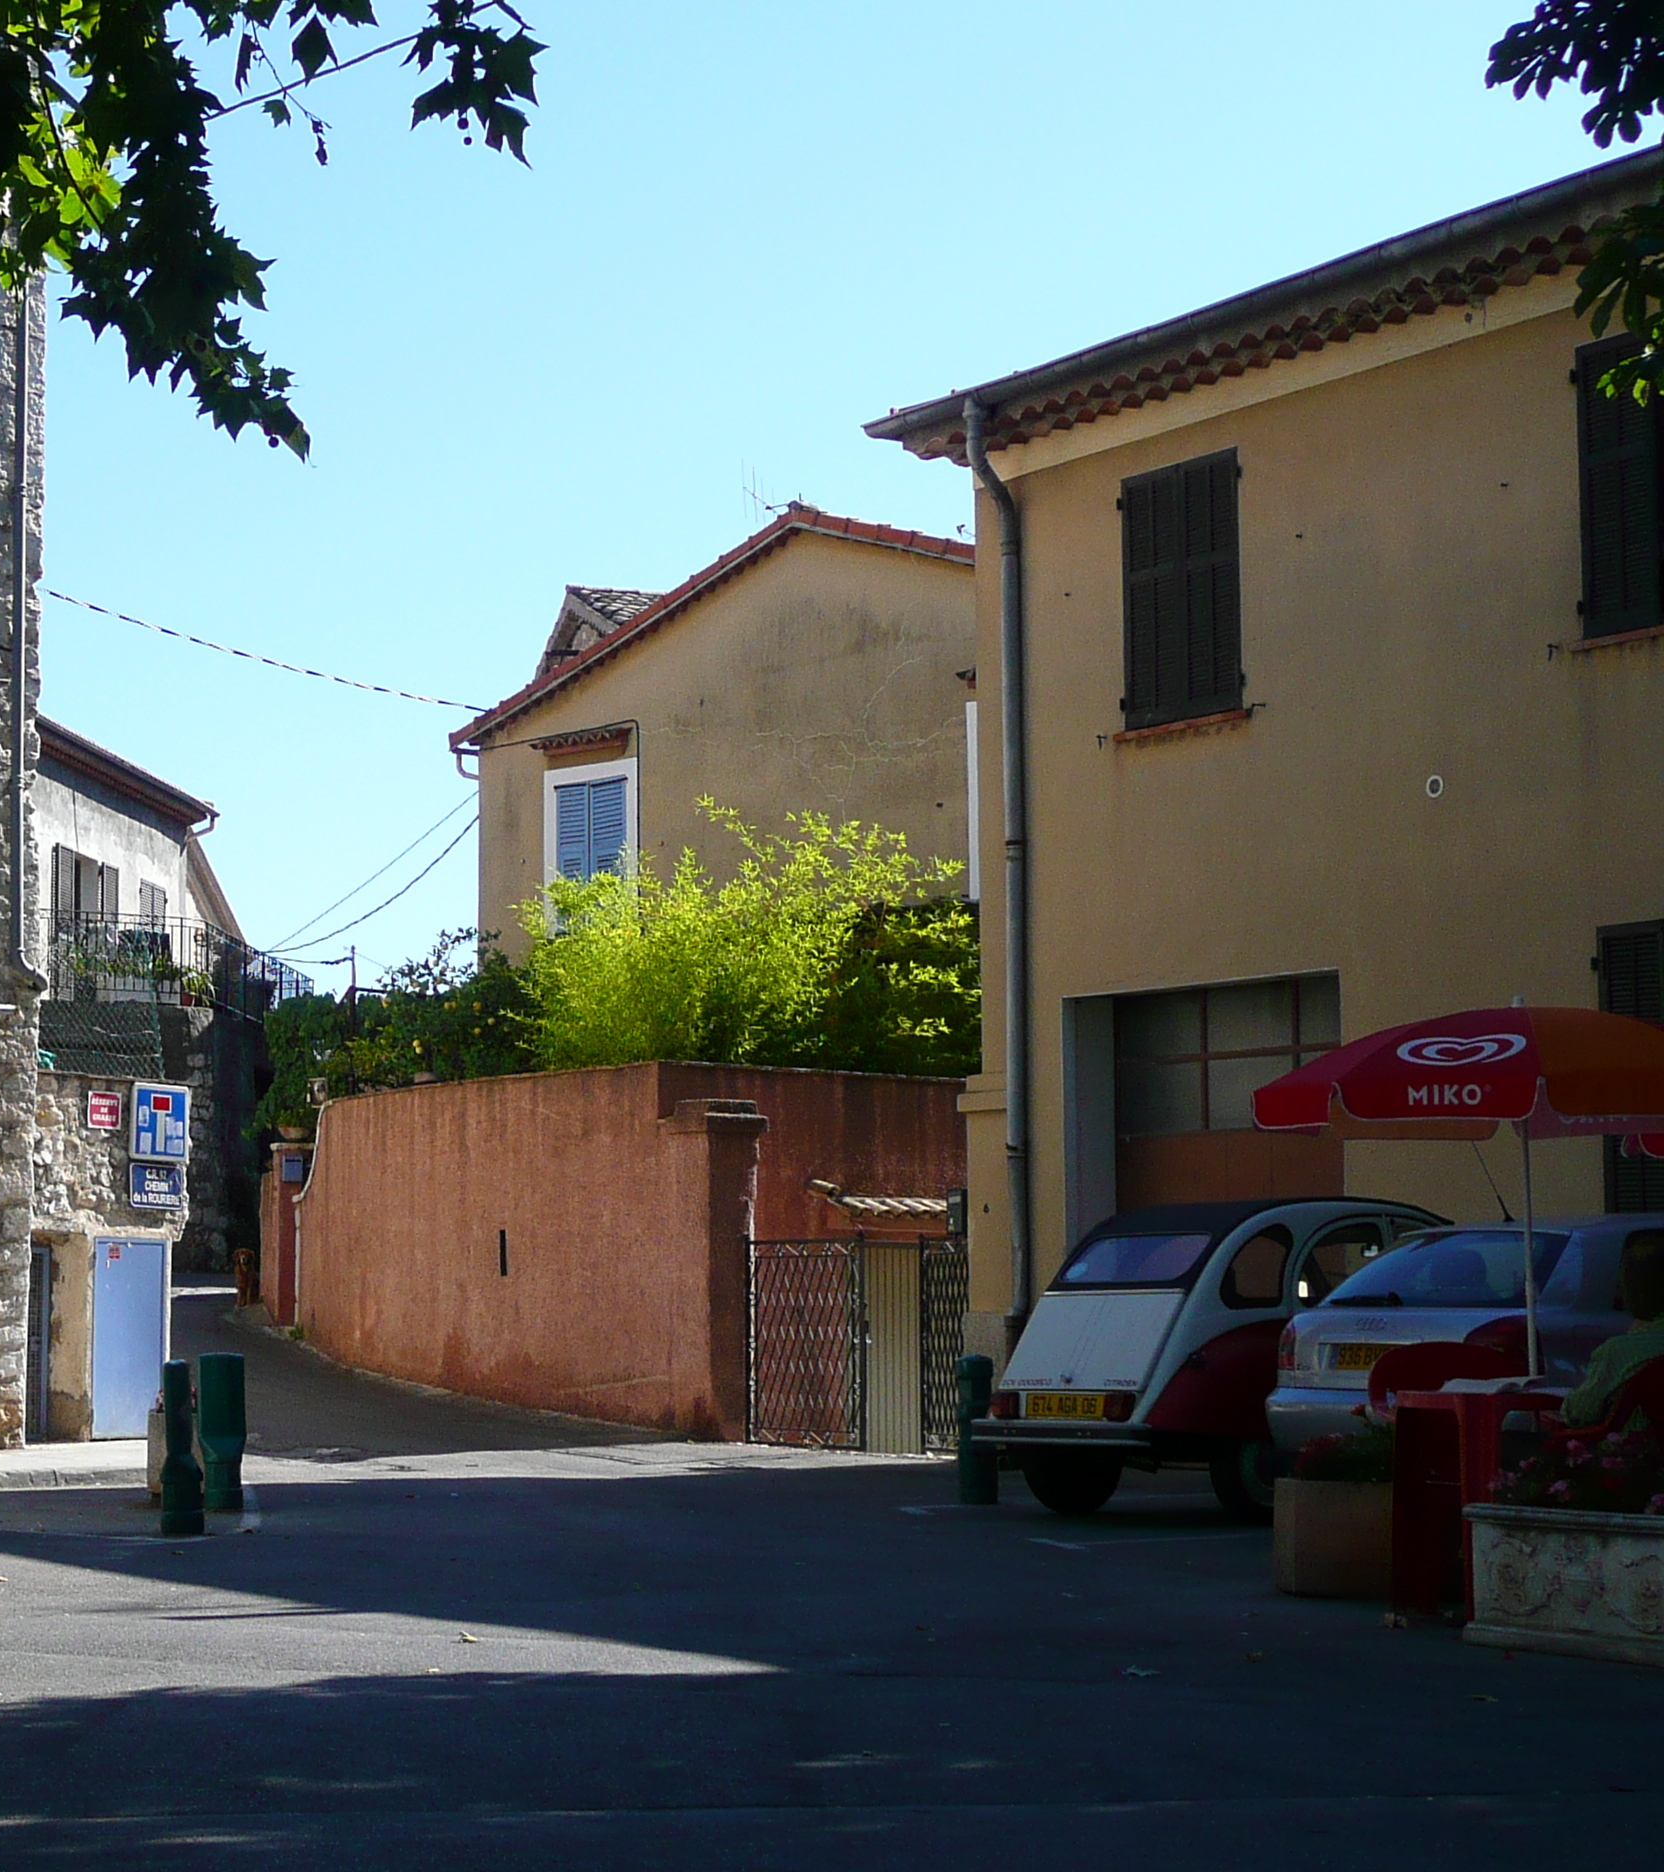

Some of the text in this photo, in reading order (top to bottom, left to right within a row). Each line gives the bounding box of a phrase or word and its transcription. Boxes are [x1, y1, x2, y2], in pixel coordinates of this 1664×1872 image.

[1407, 1084, 1481, 1106] MIKO
[1363, 1347, 1390, 1365] BV
[1032, 1396, 1053, 1413] 674
